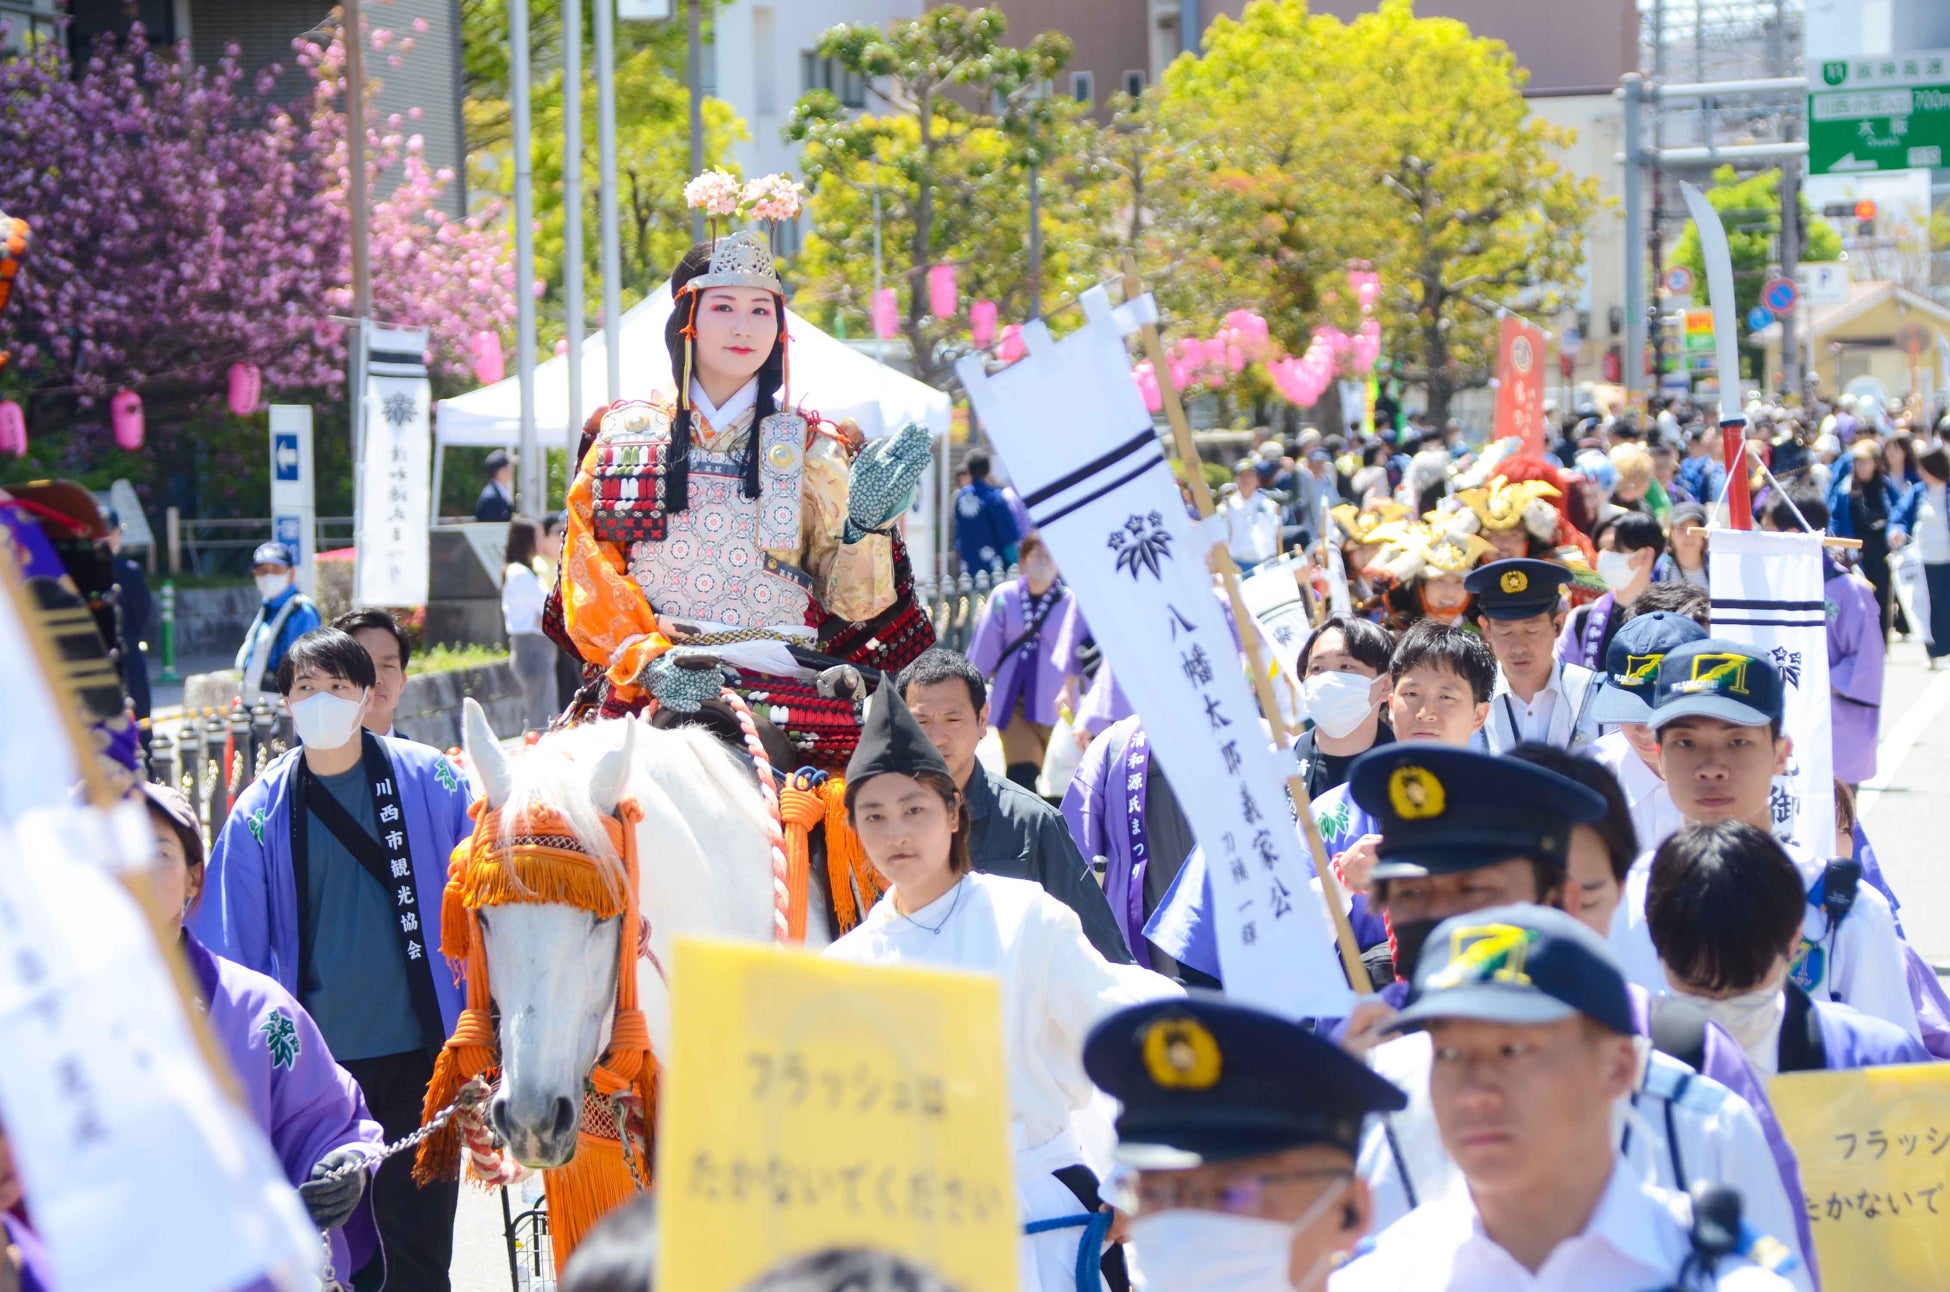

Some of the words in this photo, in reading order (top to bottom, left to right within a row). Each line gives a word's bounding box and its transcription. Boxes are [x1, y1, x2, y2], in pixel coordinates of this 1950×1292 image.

[375, 778, 422, 960] 川西市観光協会
[1127, 731, 1147, 880] 清和源氏まつり
